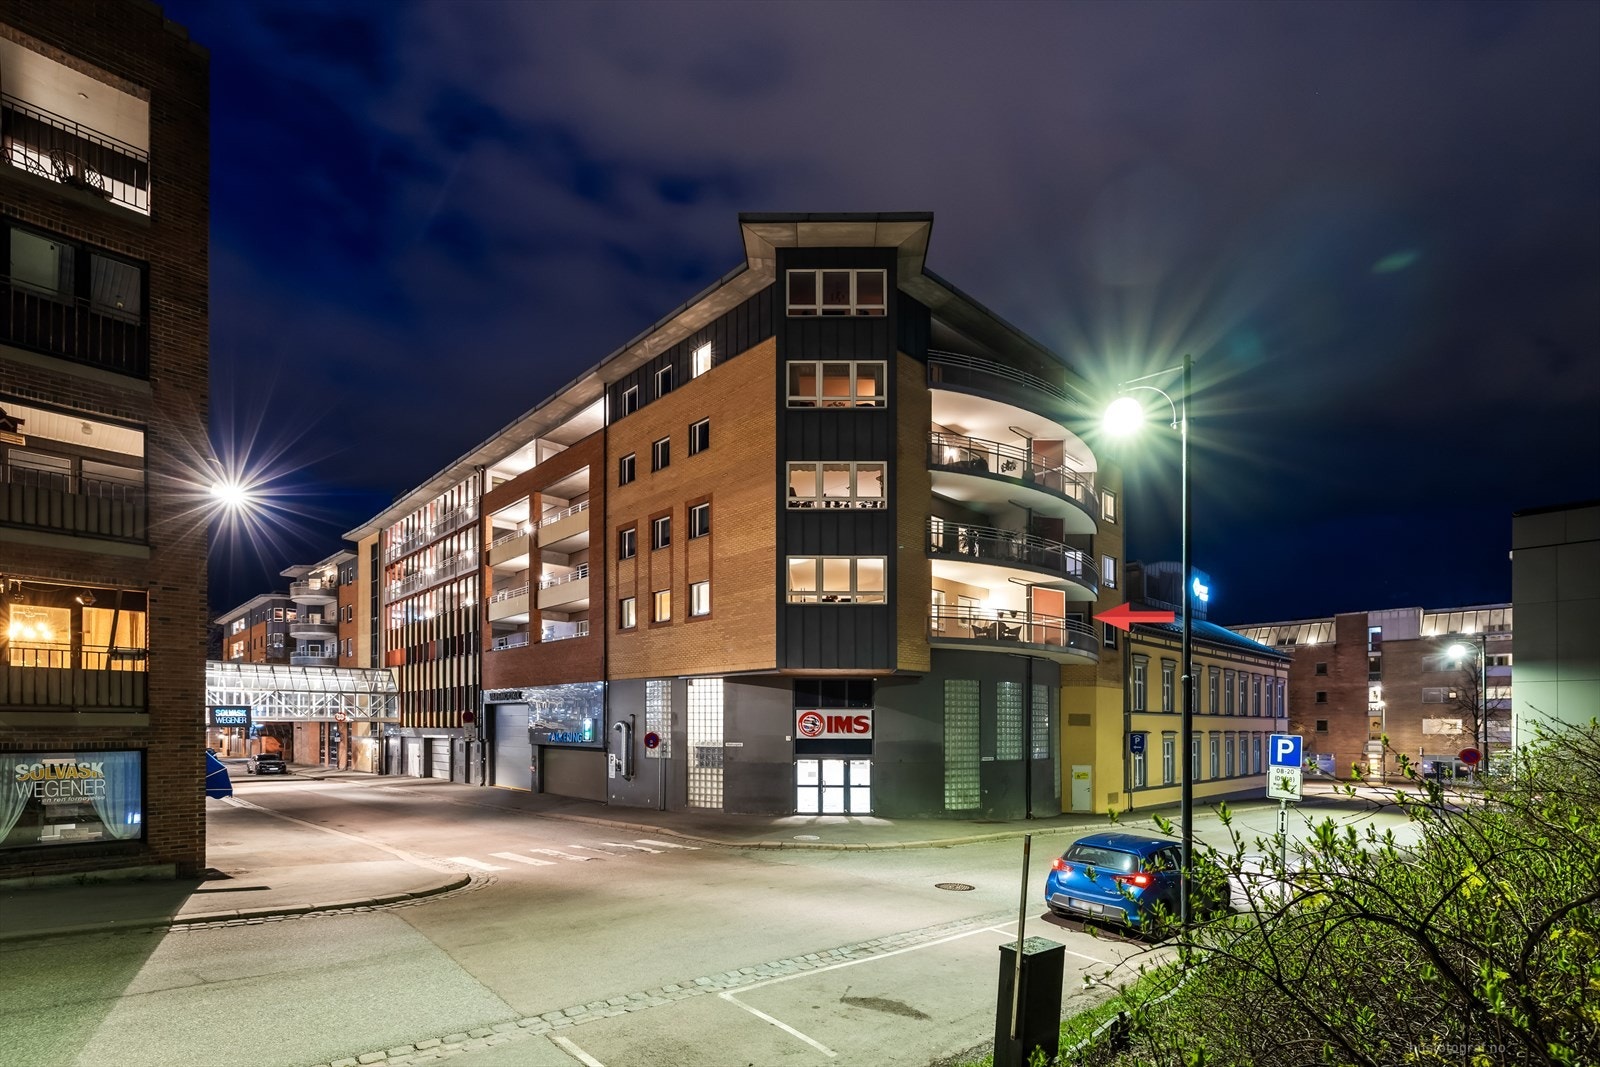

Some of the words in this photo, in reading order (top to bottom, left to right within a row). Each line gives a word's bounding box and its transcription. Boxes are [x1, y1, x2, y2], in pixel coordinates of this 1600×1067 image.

[215, 709, 247, 717] SOLVASK
[826, 715, 869, 734] IMS
[548, 732, 583, 743] PARKERING
[1277, 739, 1294, 762] P
[15, 762, 105, 780] SOLVASK
[15, 779, 106, 798] WEGENER
